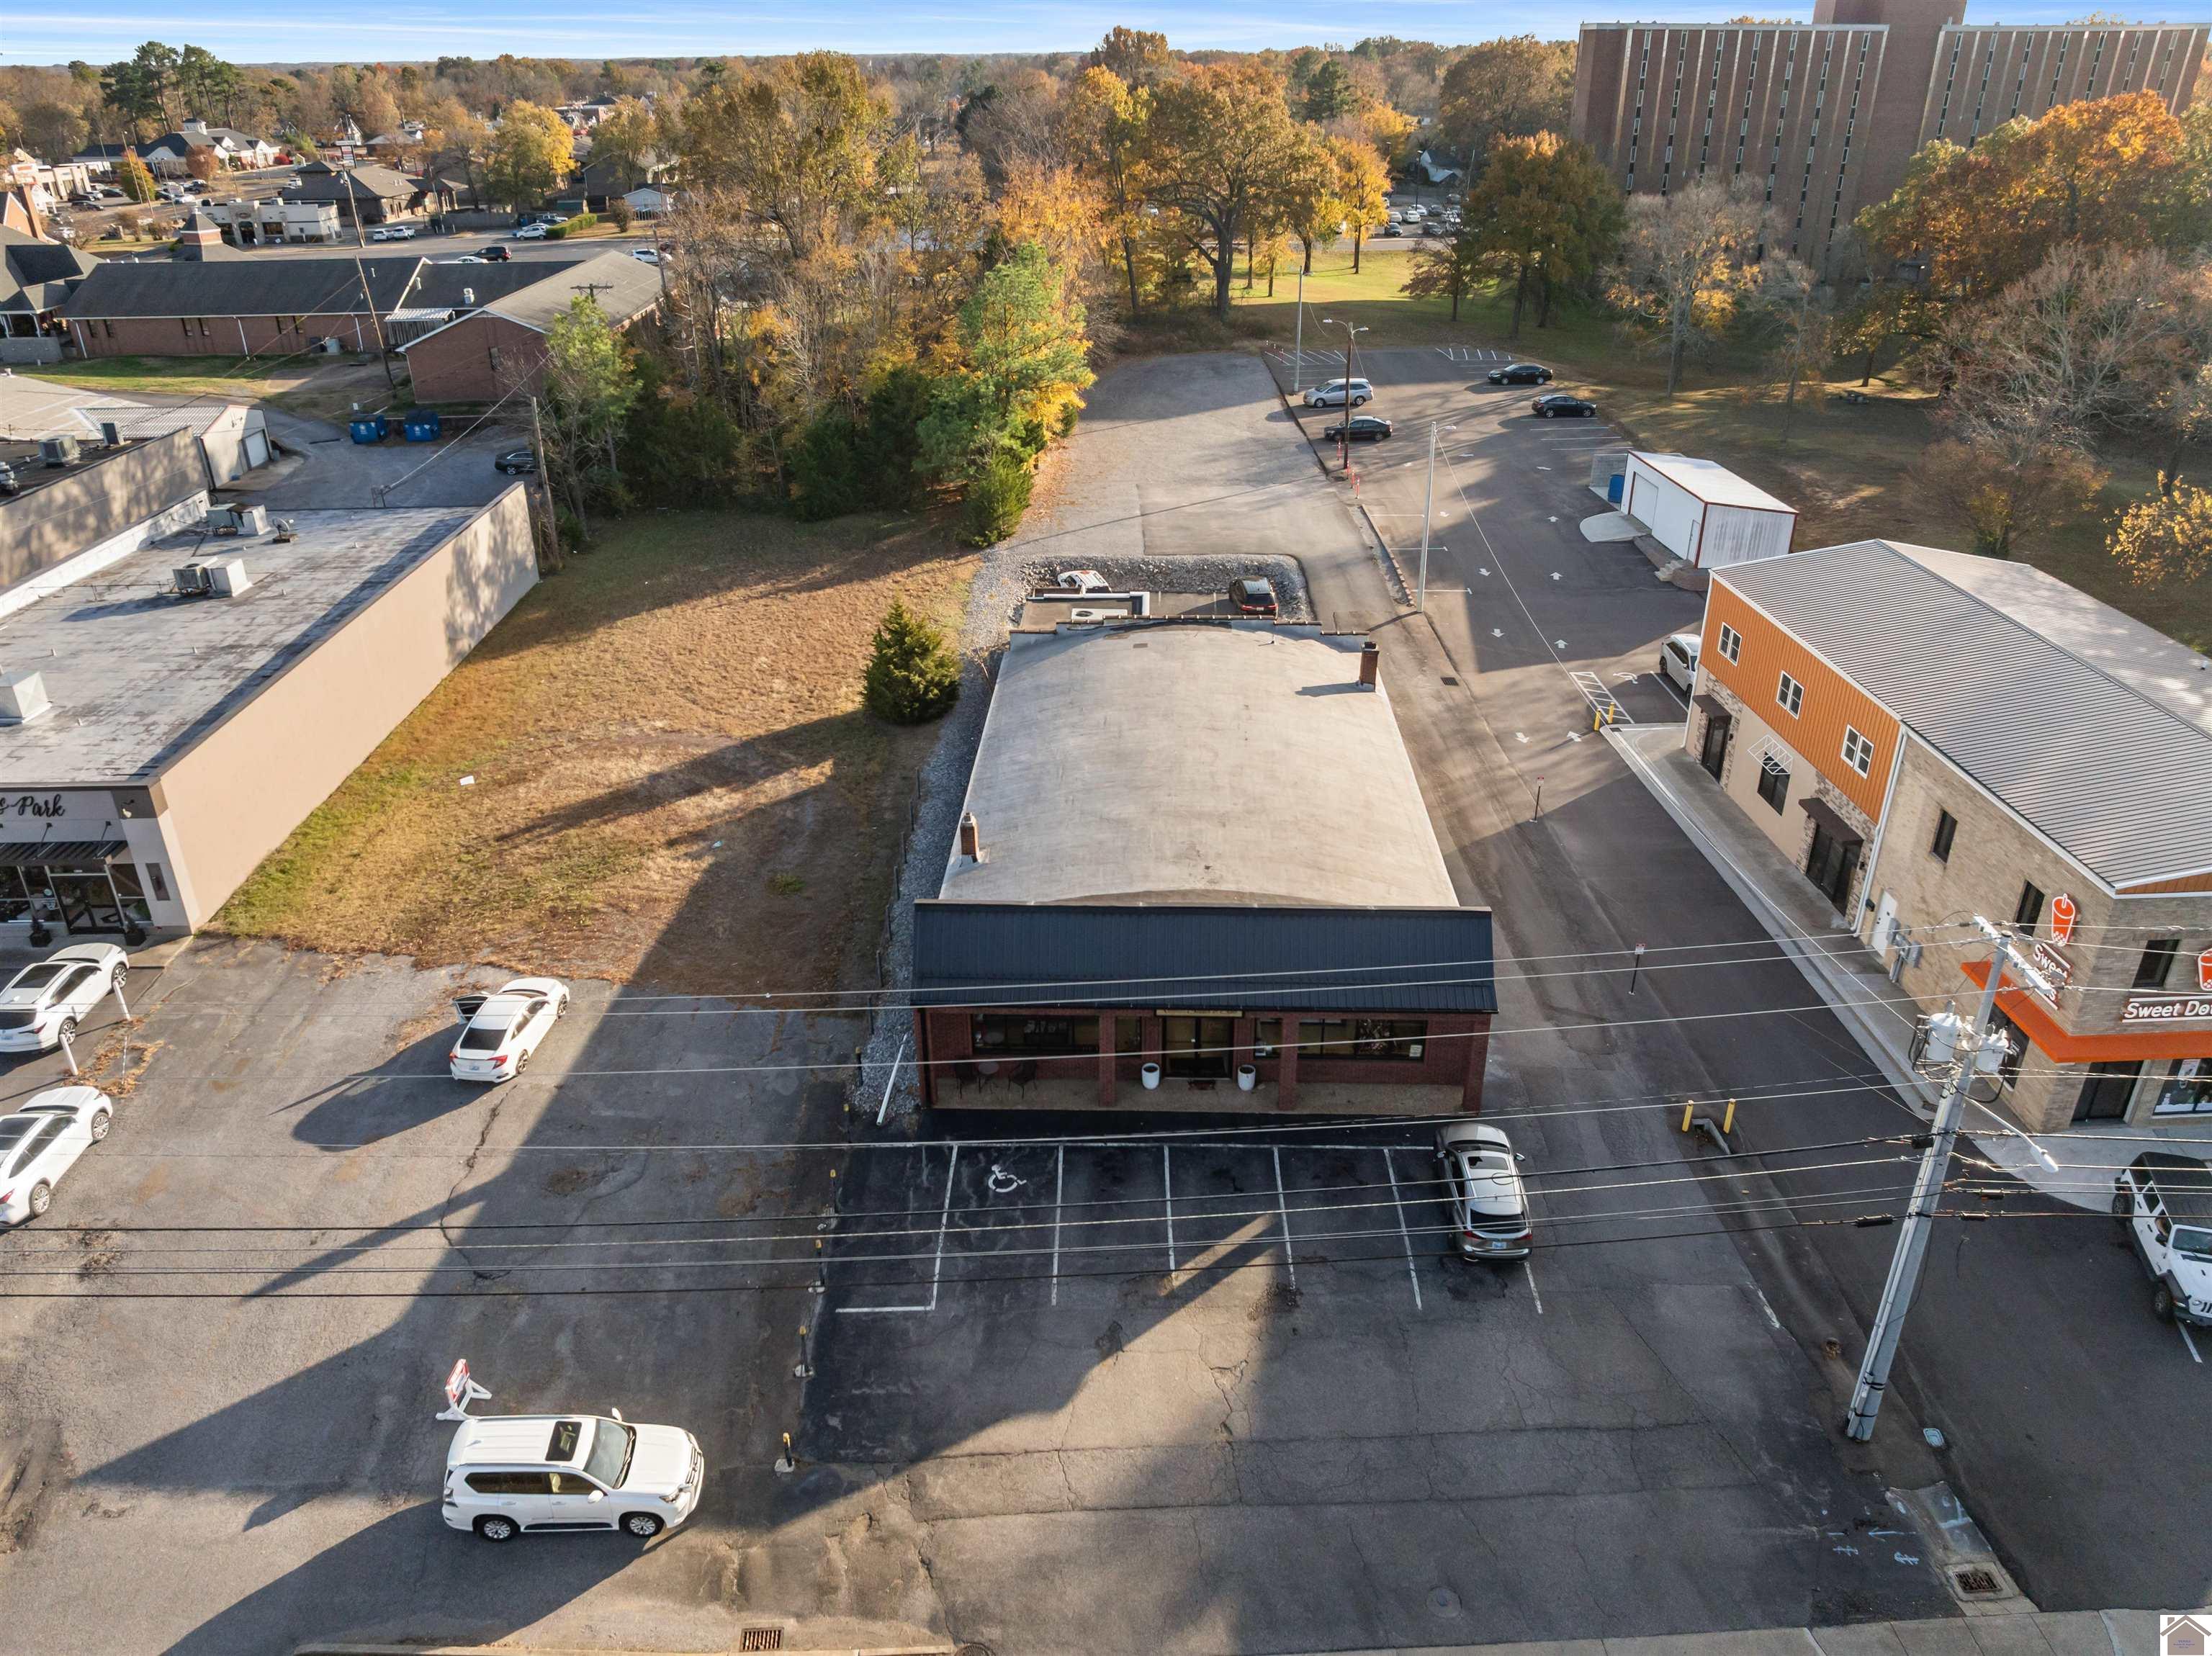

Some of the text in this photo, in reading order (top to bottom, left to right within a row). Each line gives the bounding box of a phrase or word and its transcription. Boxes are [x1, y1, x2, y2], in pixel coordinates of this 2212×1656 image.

[10, 793, 66, 818] Park
[2123, 1000, 2212, 1019] Sweet Do
